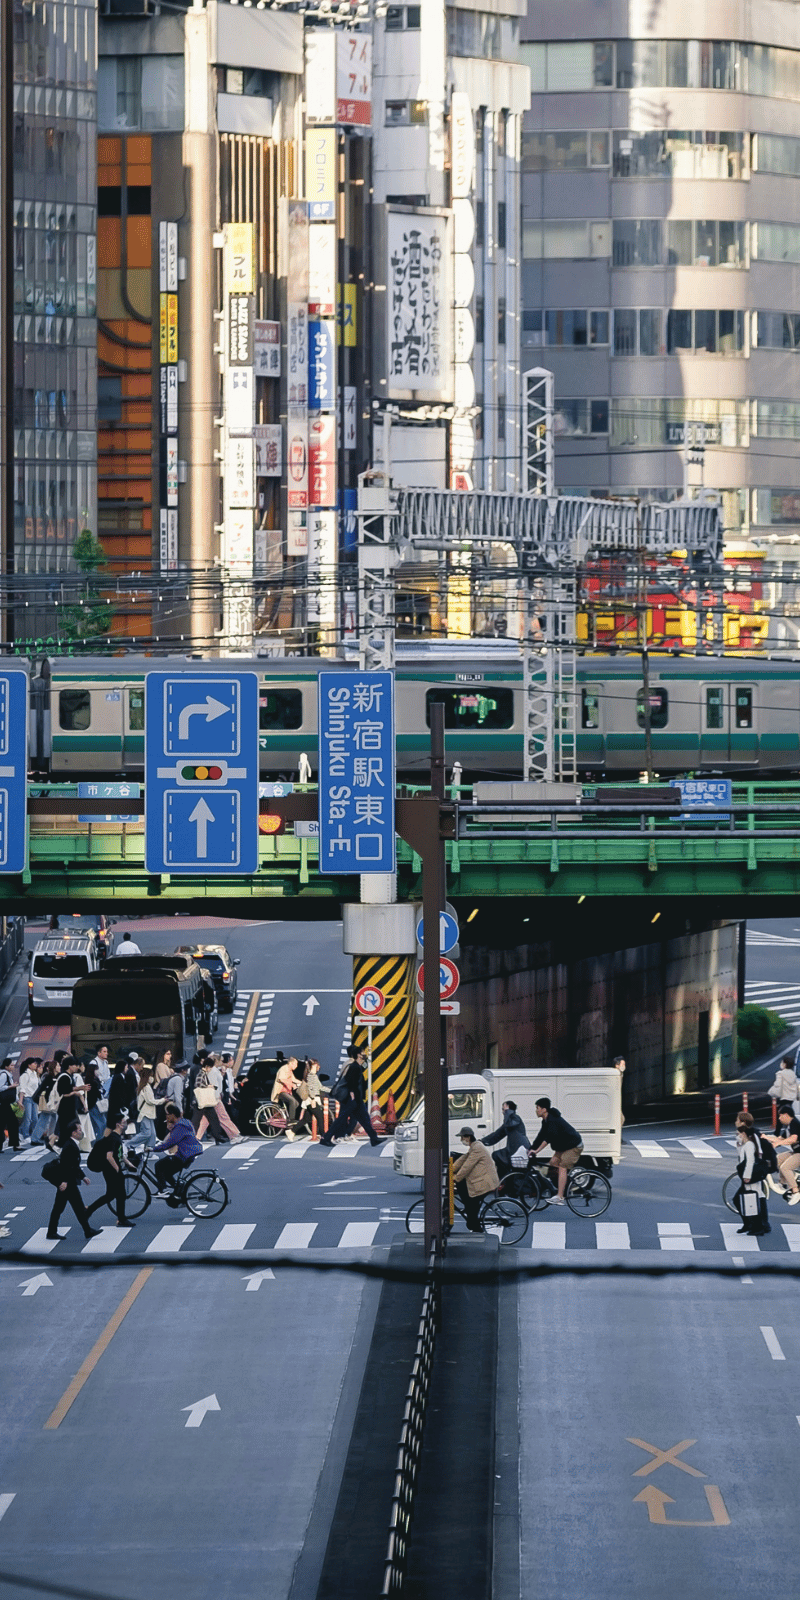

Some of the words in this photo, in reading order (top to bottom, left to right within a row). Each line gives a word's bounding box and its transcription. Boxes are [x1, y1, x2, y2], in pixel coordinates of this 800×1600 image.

[311, 330, 328, 399] セントラル
[324, 687, 350, 777] Shinjuku
[352, 682, 385, 861] 新宿駅東口
[328, 785, 351, 858] Sta.-E.
